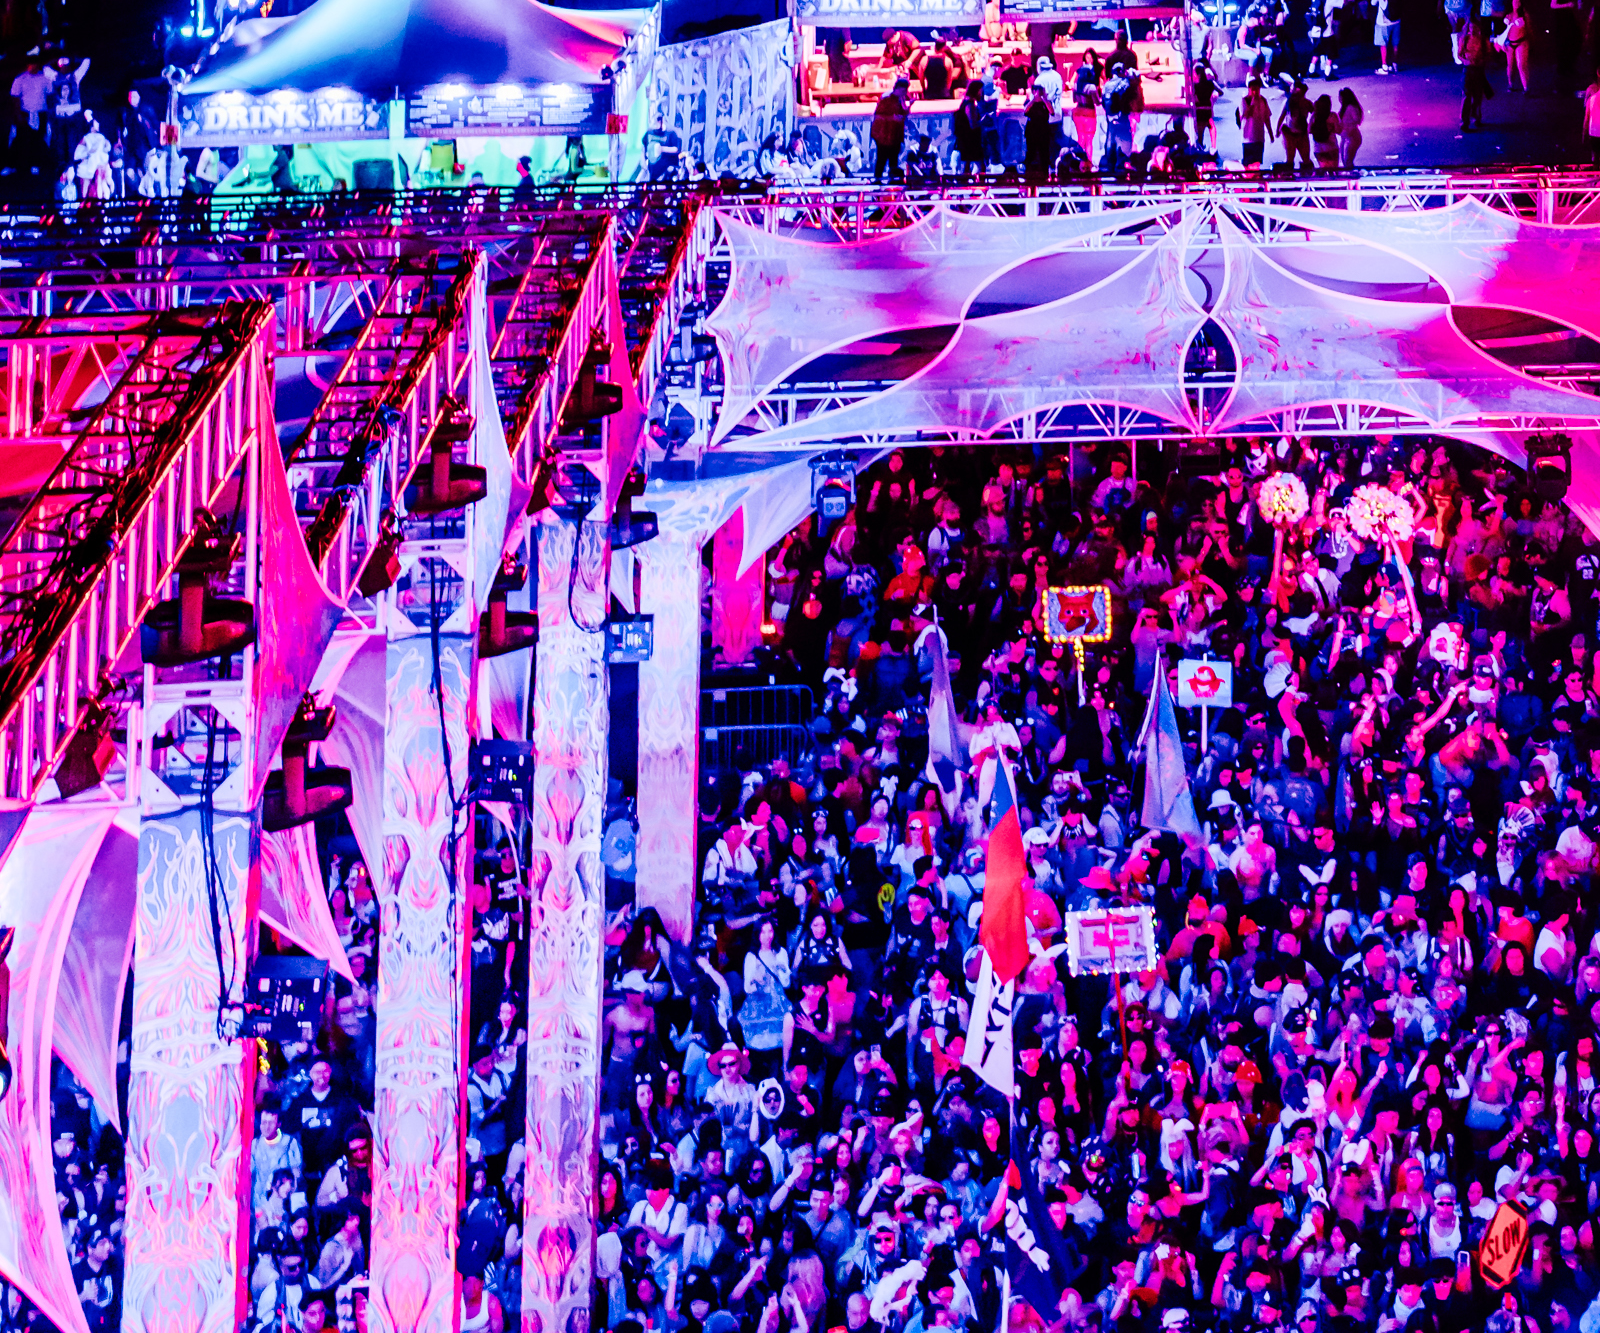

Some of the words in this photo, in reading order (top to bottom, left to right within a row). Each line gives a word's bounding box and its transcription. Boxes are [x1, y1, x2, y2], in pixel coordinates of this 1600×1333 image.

[203, 103, 311, 132] DRINK
[315, 101, 365, 129] ME
[1486, 1217, 1522, 1266] SLOW
